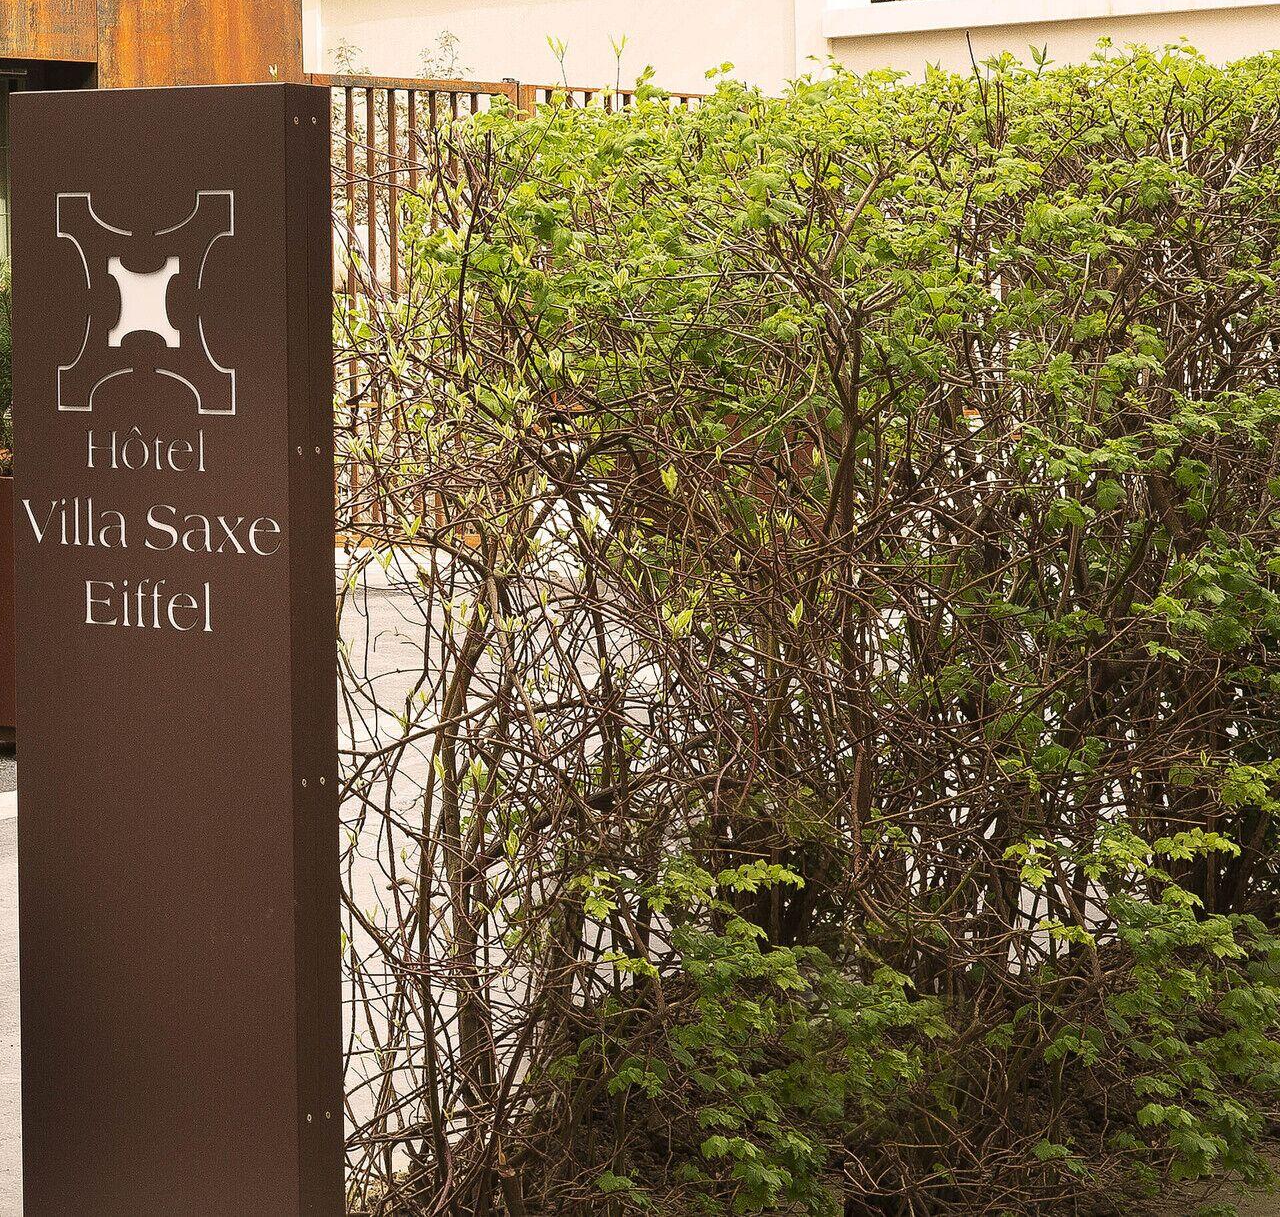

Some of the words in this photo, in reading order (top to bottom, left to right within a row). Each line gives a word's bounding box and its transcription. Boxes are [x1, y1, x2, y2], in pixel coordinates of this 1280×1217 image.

[86, 425, 206, 472] Hôtel
[21, 496, 128, 548] Villa
[144, 504, 282, 556] Saxe
[85, 578, 214, 632] Eiffel
